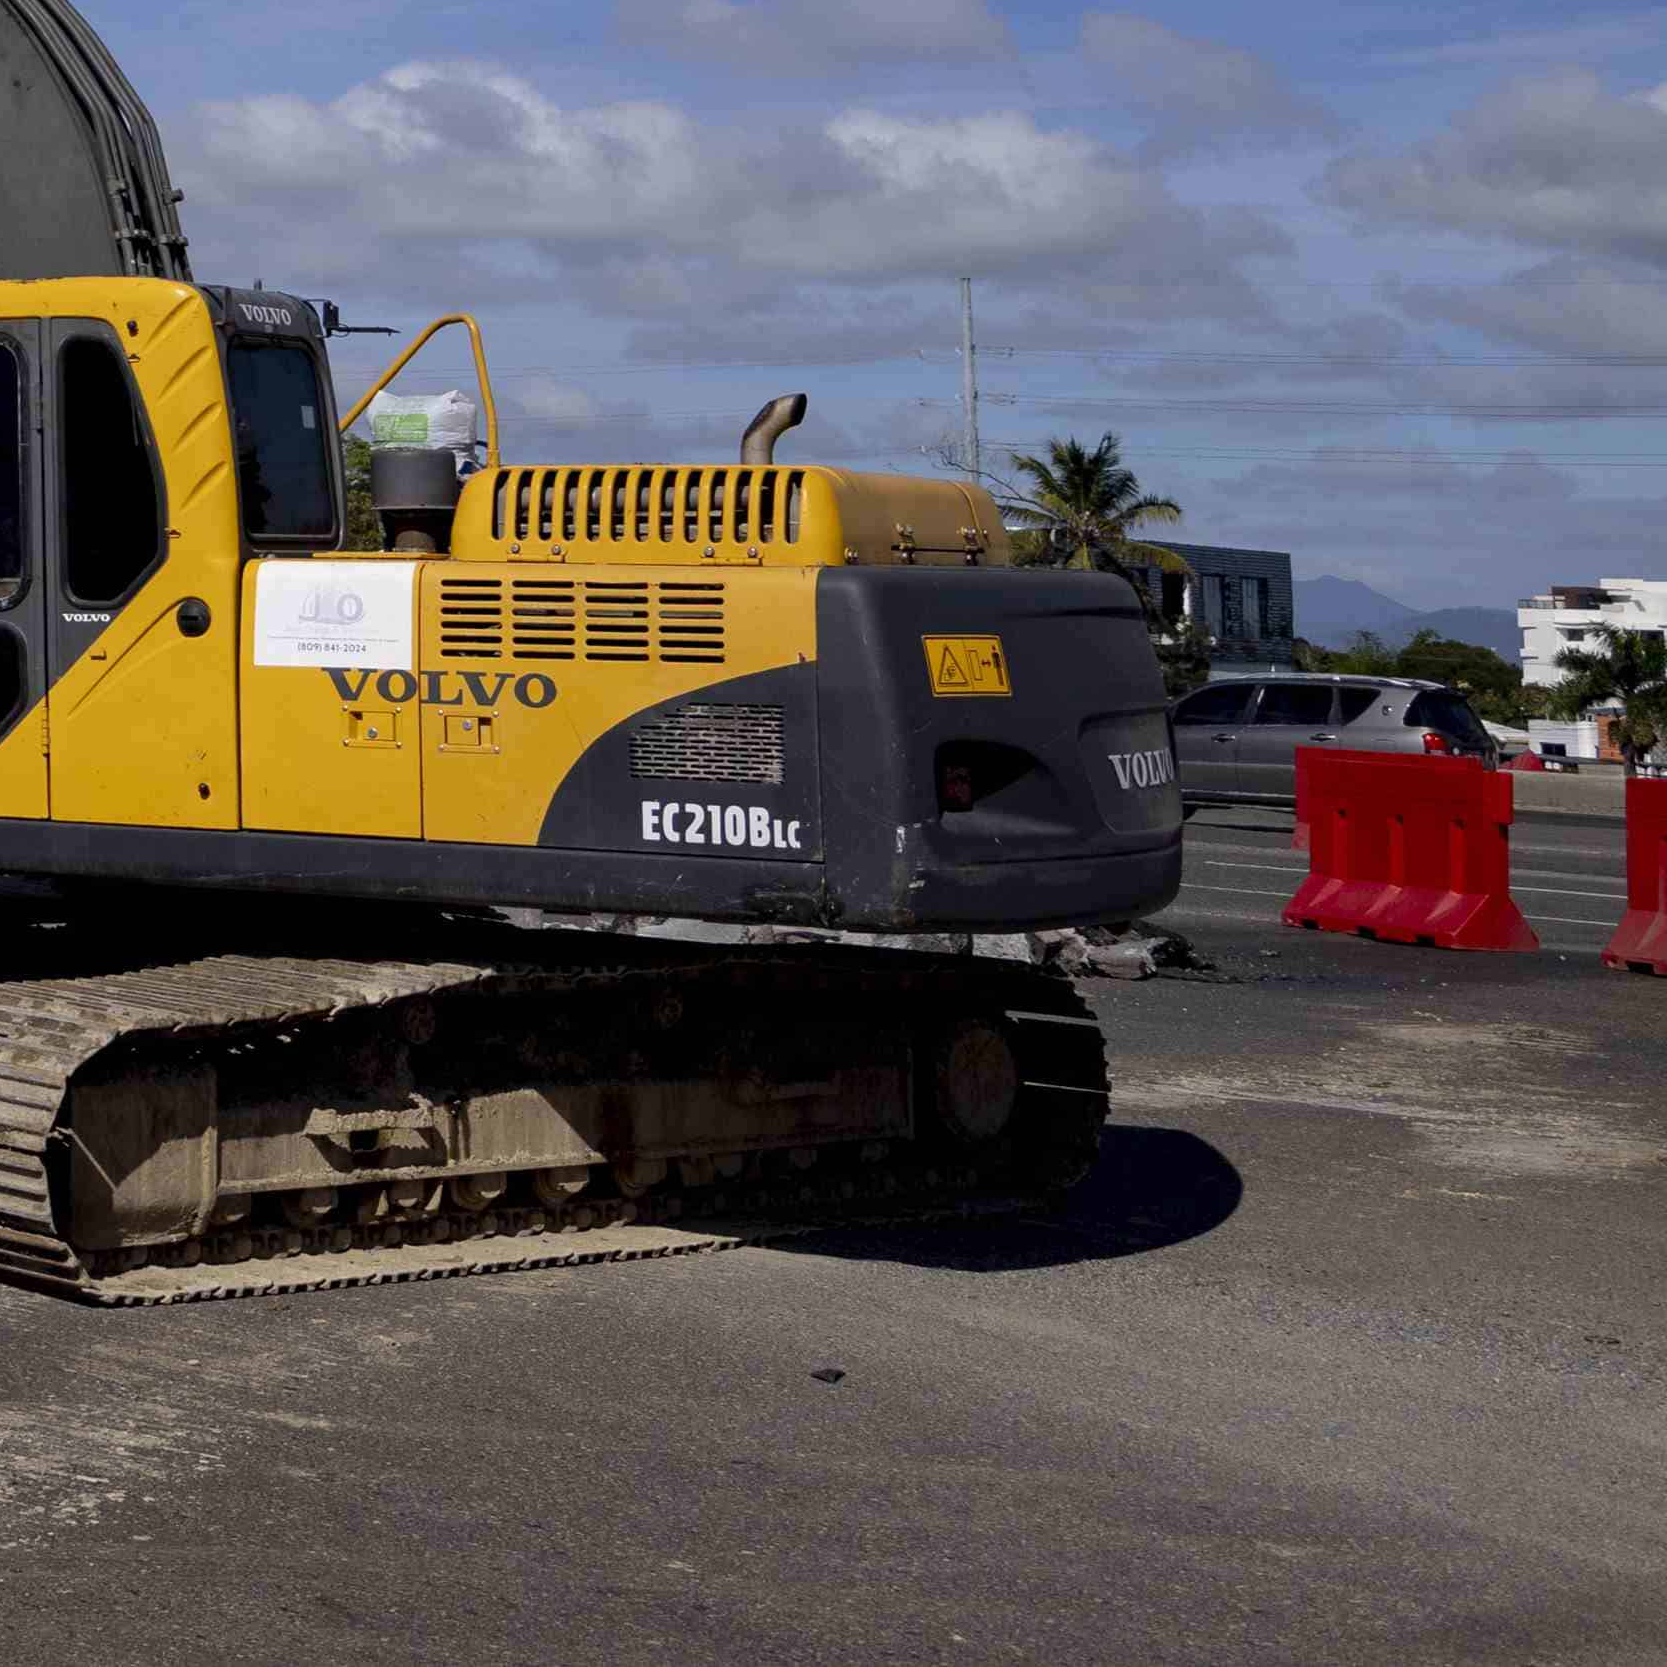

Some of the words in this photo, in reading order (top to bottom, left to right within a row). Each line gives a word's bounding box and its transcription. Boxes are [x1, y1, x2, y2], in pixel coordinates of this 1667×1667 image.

[238, 303, 292, 326] VOLVO
[62, 613, 111, 622] VOLVO
[297, 642, 322, 653] (809)
[321, 667, 557, 708] VOLVO
